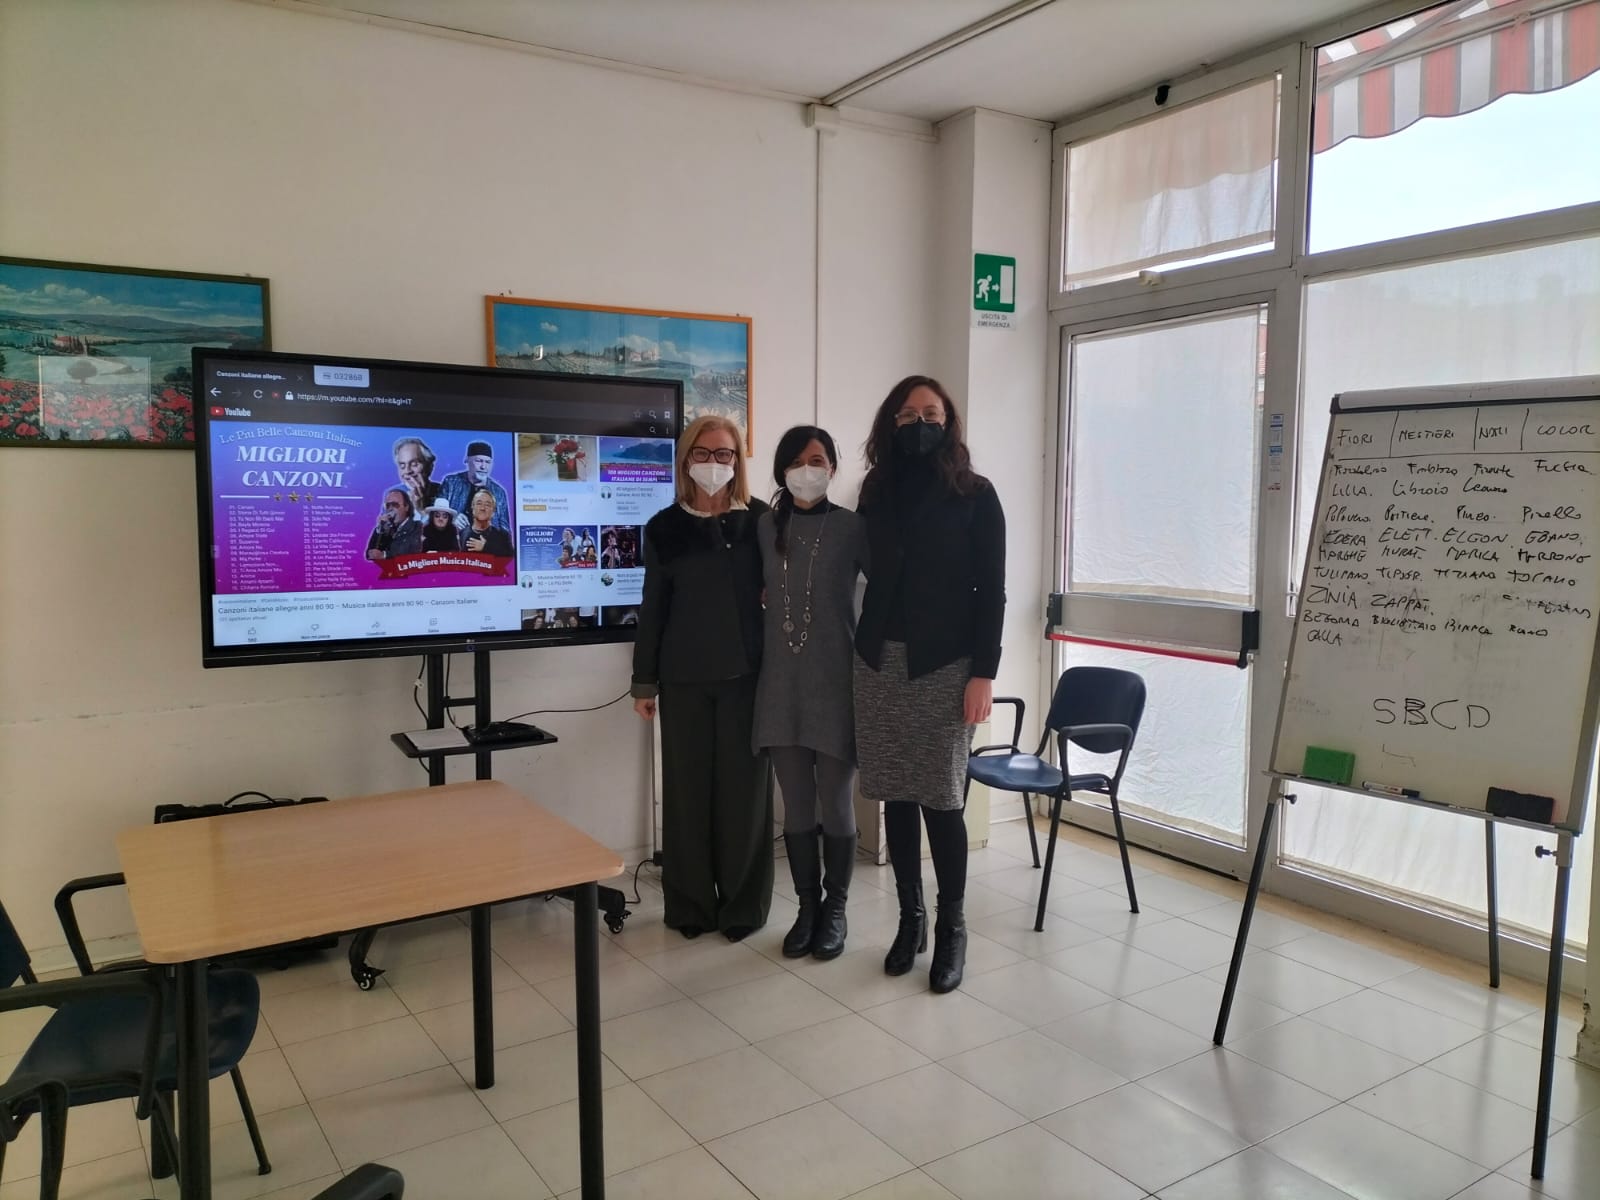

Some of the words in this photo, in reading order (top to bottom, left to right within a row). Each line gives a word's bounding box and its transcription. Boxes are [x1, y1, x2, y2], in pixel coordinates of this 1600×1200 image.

[977, 320, 1011, 328] EMERGENZA
[224, 407, 251, 417] YouTube
[219, 434, 235, 444] Le
[257, 427, 282, 438] Belle
[284, 426, 324, 439] Canzoni
[326, 430, 363, 448] Italiane
[1337, 428, 1373, 445] FIORI
[1399, 428, 1455, 443] MESTIERI
[235, 445, 348, 464] MIGLIORI
[241, 470, 344, 488] CANZONI
[398, 563, 408, 571] La
[408, 558, 439, 570] Migliore
[440, 556, 465, 566] Musica
[465, 558, 493, 569] Italiana
[218, 606, 247, 615] Canzoni
[274, 605, 298, 615] allegre
